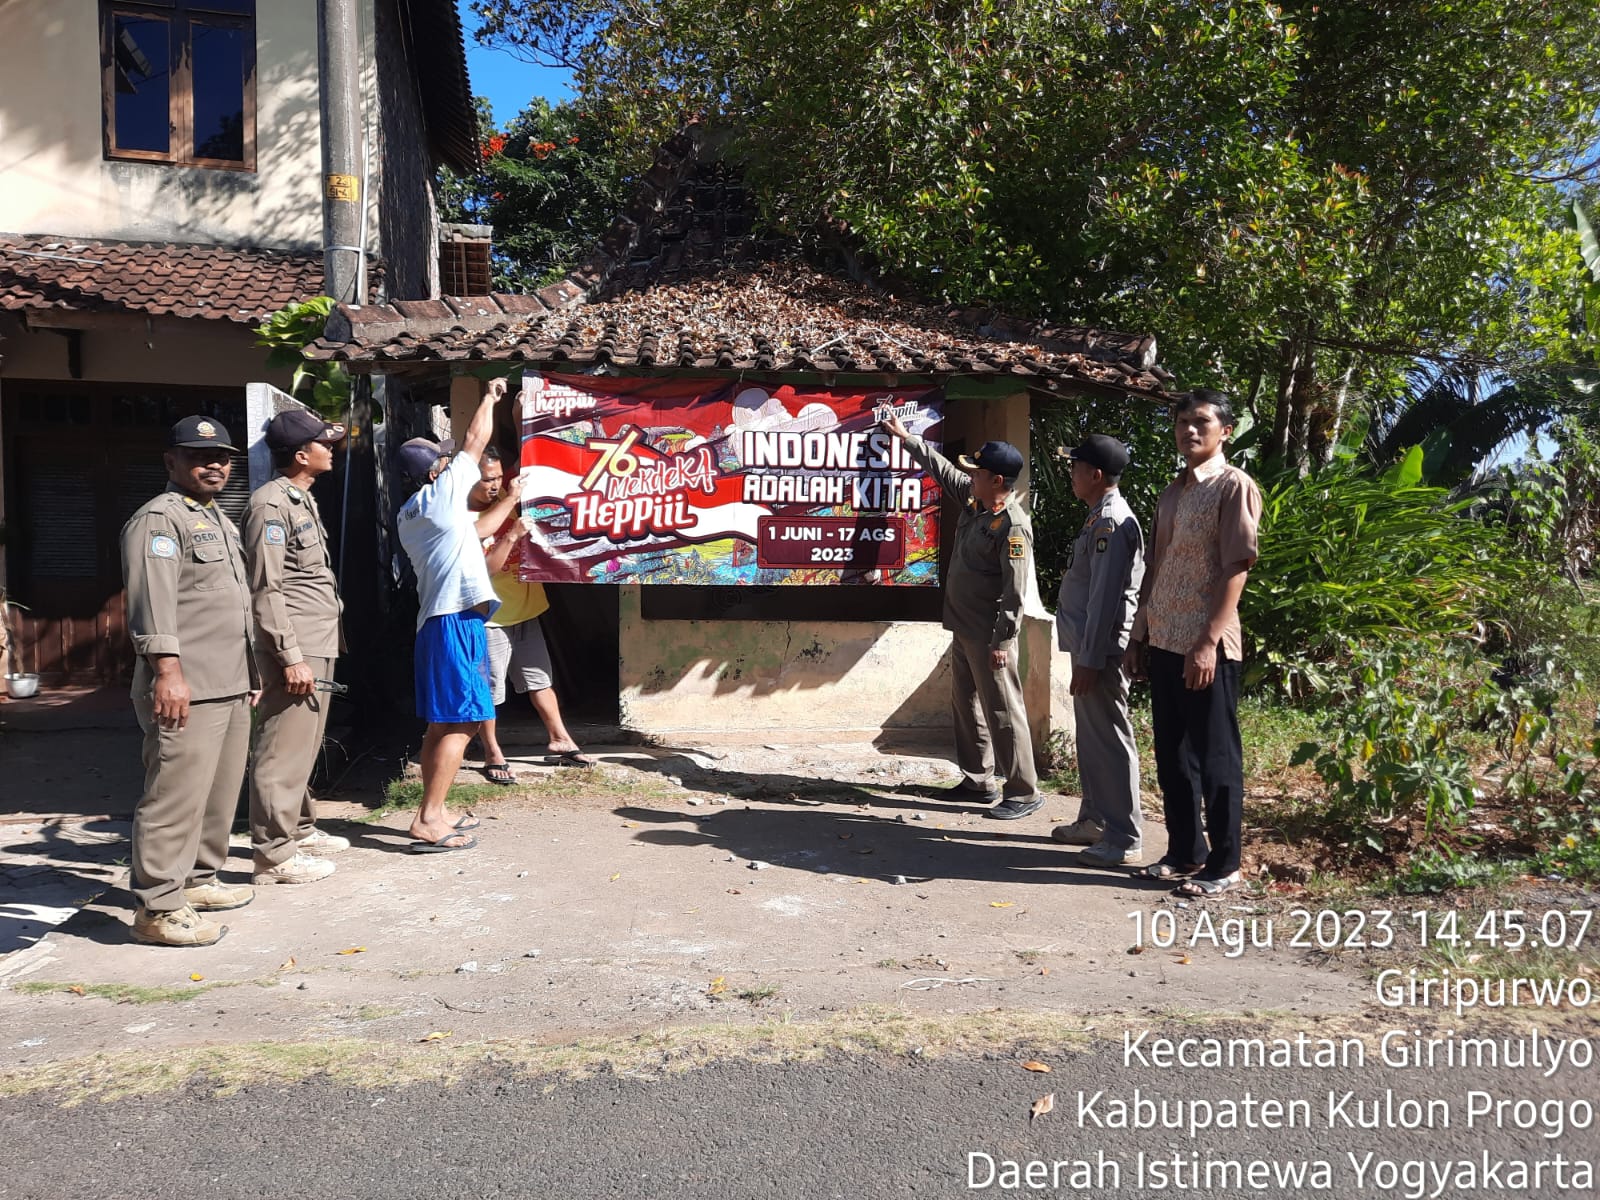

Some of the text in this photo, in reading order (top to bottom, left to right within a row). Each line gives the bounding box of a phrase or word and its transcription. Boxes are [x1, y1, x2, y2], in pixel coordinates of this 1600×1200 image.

[582, 431, 638, 490] 76
[743, 475, 921, 510] ADALAH KITA
[768, 527, 776, 540] 1
[780, 527, 822, 541] JUNI
[838, 527, 855, 541] 17
[859, 528, 895, 542] AGS
[811, 548, 854, 562] 2023
